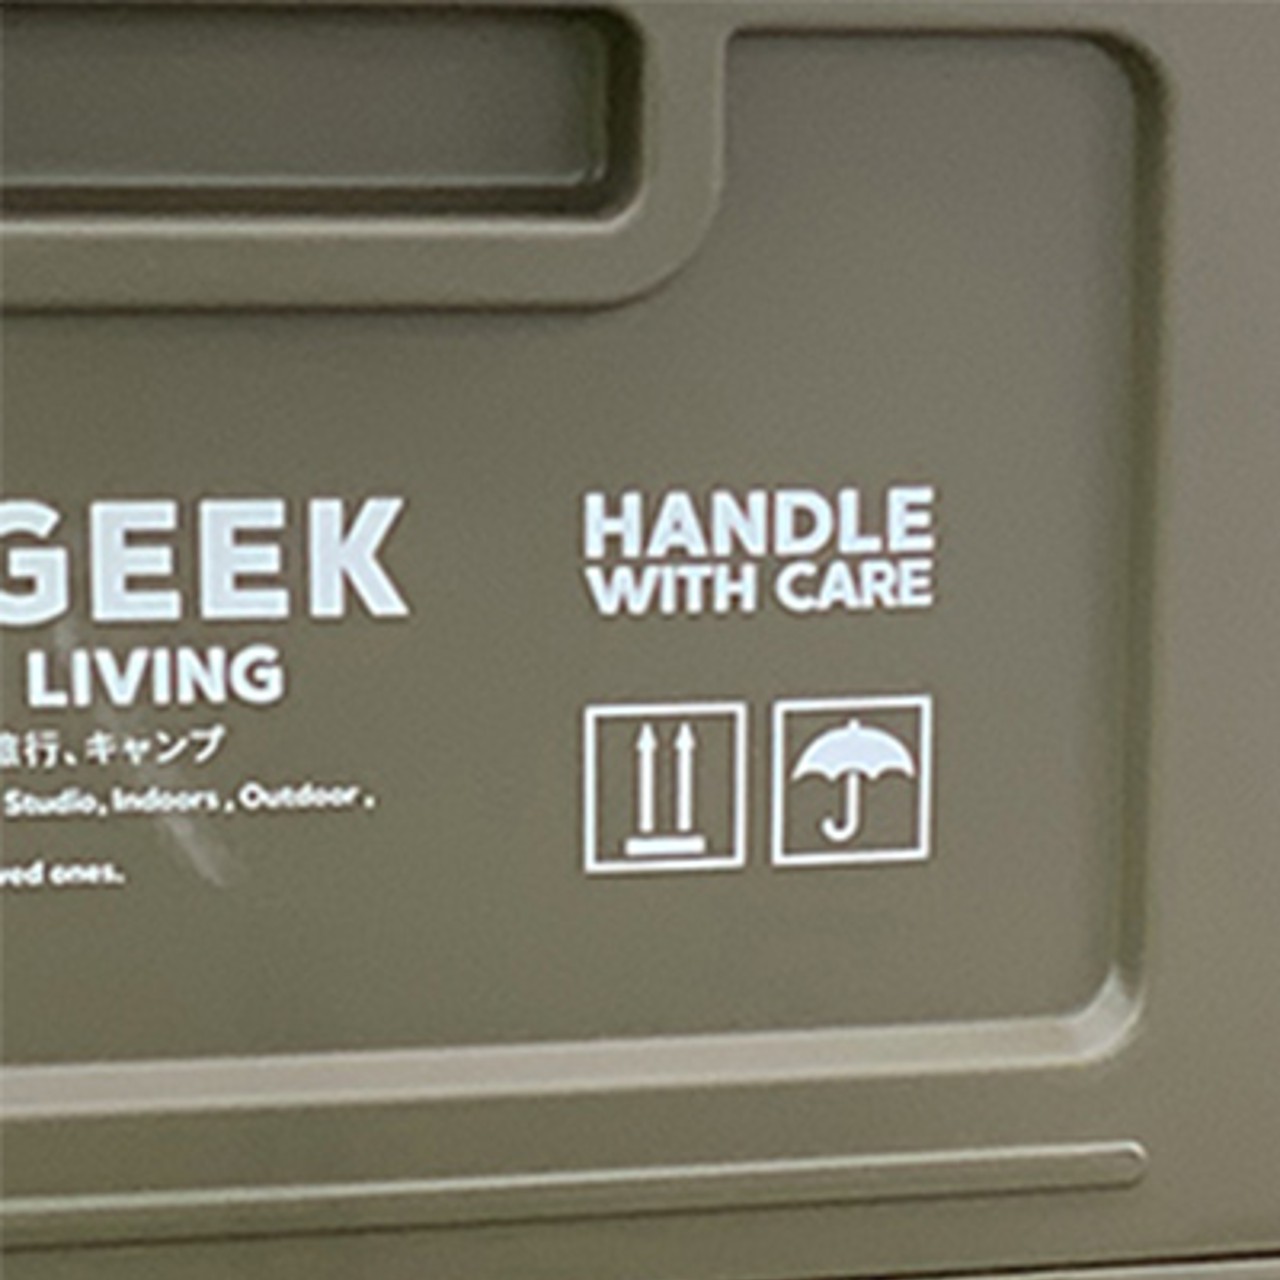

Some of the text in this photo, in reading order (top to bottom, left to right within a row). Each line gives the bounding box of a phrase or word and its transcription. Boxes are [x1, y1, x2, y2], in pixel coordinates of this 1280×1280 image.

[585, 486, 935, 558] HANDLE
[585, 559, 933, 614] WITH CARE
[28, 645, 282, 707] LIVING
